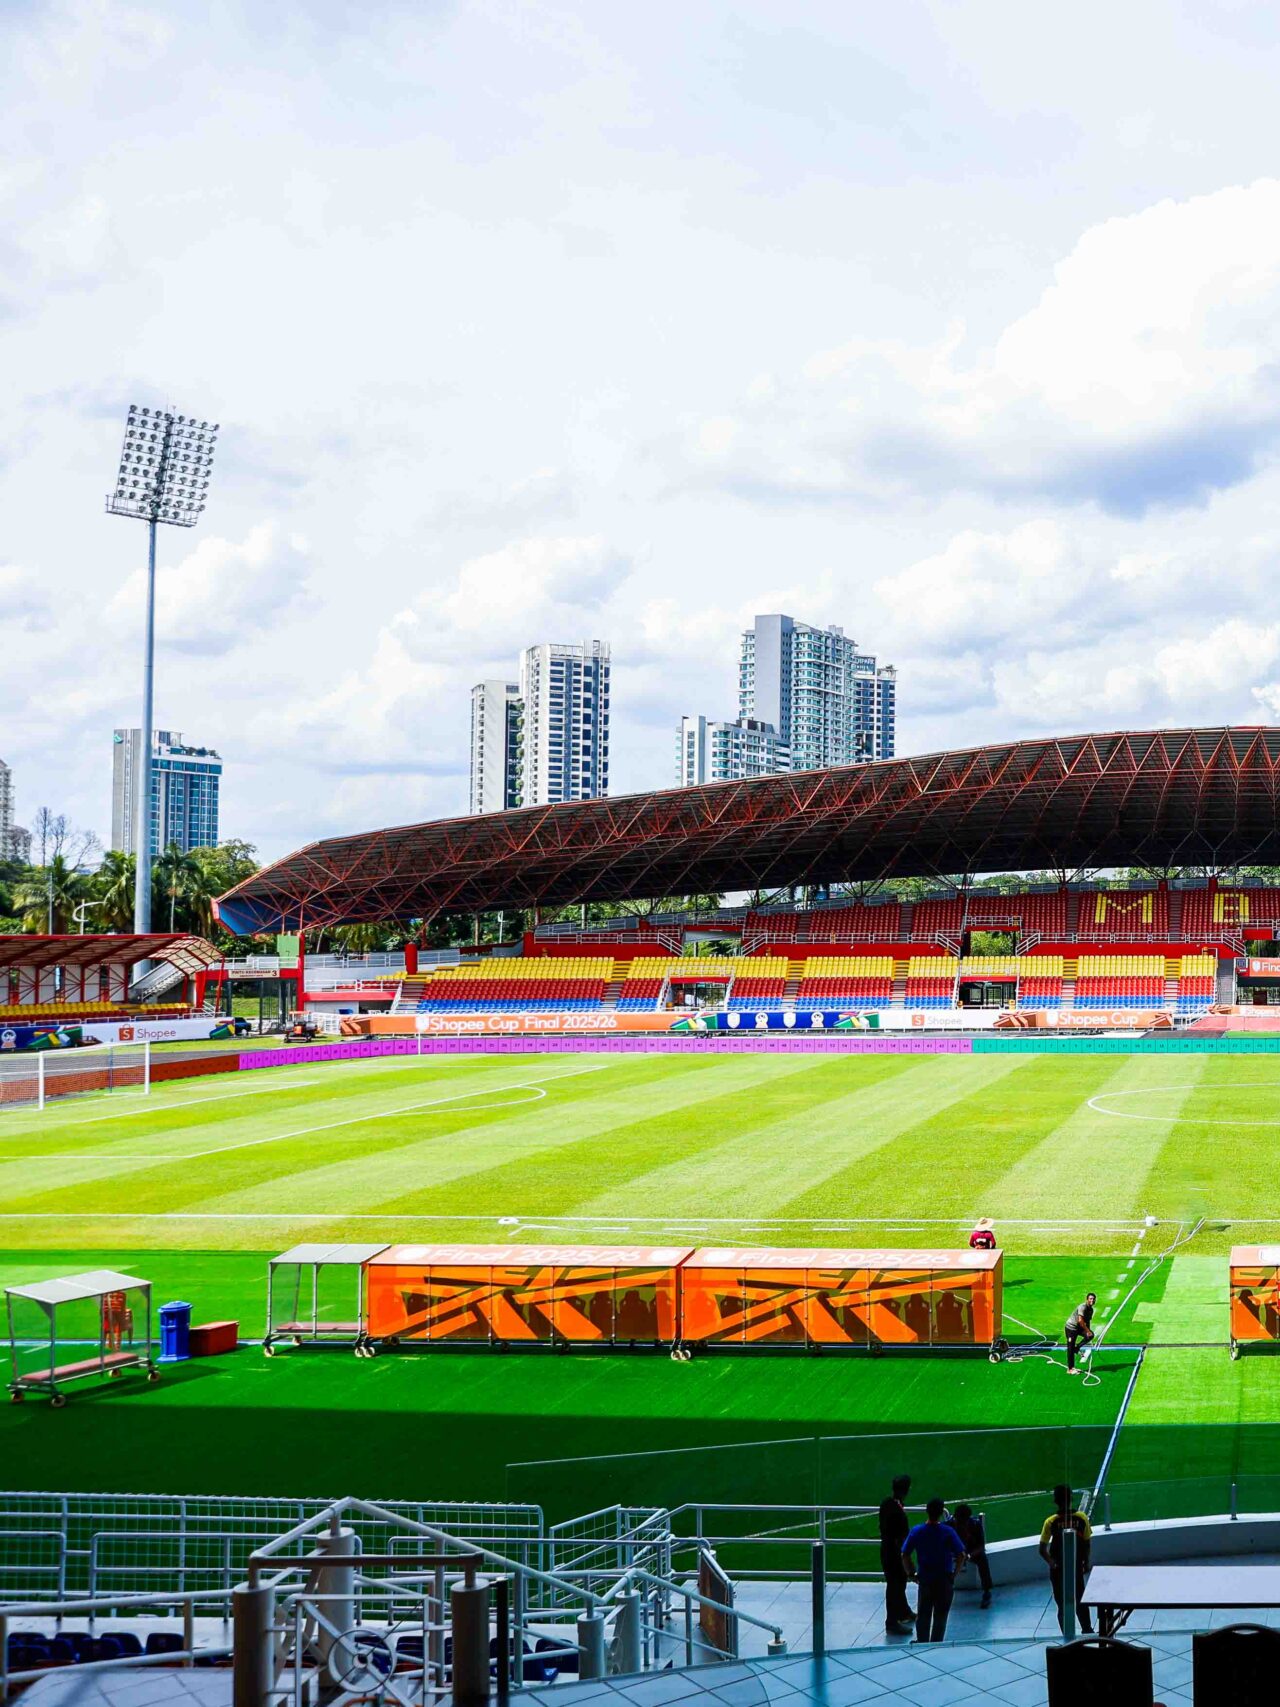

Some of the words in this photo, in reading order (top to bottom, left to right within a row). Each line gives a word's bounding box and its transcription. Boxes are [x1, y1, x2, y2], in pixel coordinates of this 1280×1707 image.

[430, 1017, 484, 1032] Shopee
[488, 1017, 519, 1032] Cup
[525, 1016, 559, 1029] Final
[563, 1015, 617, 1030] 2025/26
[927, 1016, 962, 1027] Shopee
[1059, 1013, 1107, 1028] Shopee
[1111, 1013, 1138, 1028] Cup
[137, 1028, 176, 1040] Shopee
[430, 1249, 513, 1262] Final
[514, 1249, 641, 1263] 2025/26
[737, 1252, 819, 1264] Final
[826, 1252, 950, 1265] 2025/26
